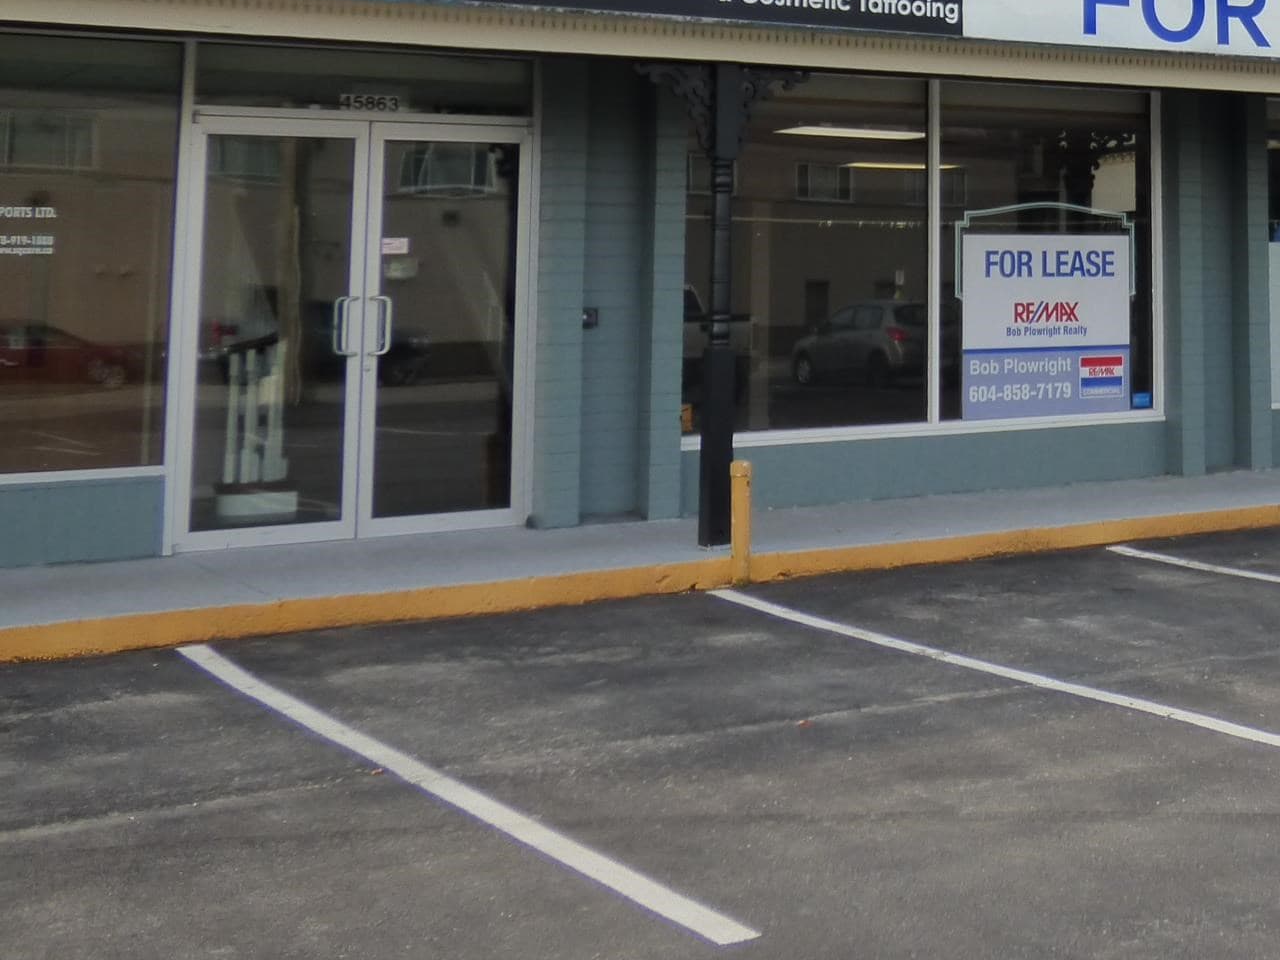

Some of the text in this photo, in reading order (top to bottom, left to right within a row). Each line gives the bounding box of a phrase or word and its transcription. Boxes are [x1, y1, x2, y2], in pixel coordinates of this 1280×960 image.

[336, 95, 399, 112] 45863
[984, 250, 1115, 278] FOR LEASE
[1013, 300, 1079, 324] RE/MAX
[1006, 325, 1088, 338] Bob Plowright Realty
[969, 356, 1072, 376] Bob Plowright
[968, 382, 1072, 402] 604-858-7179
